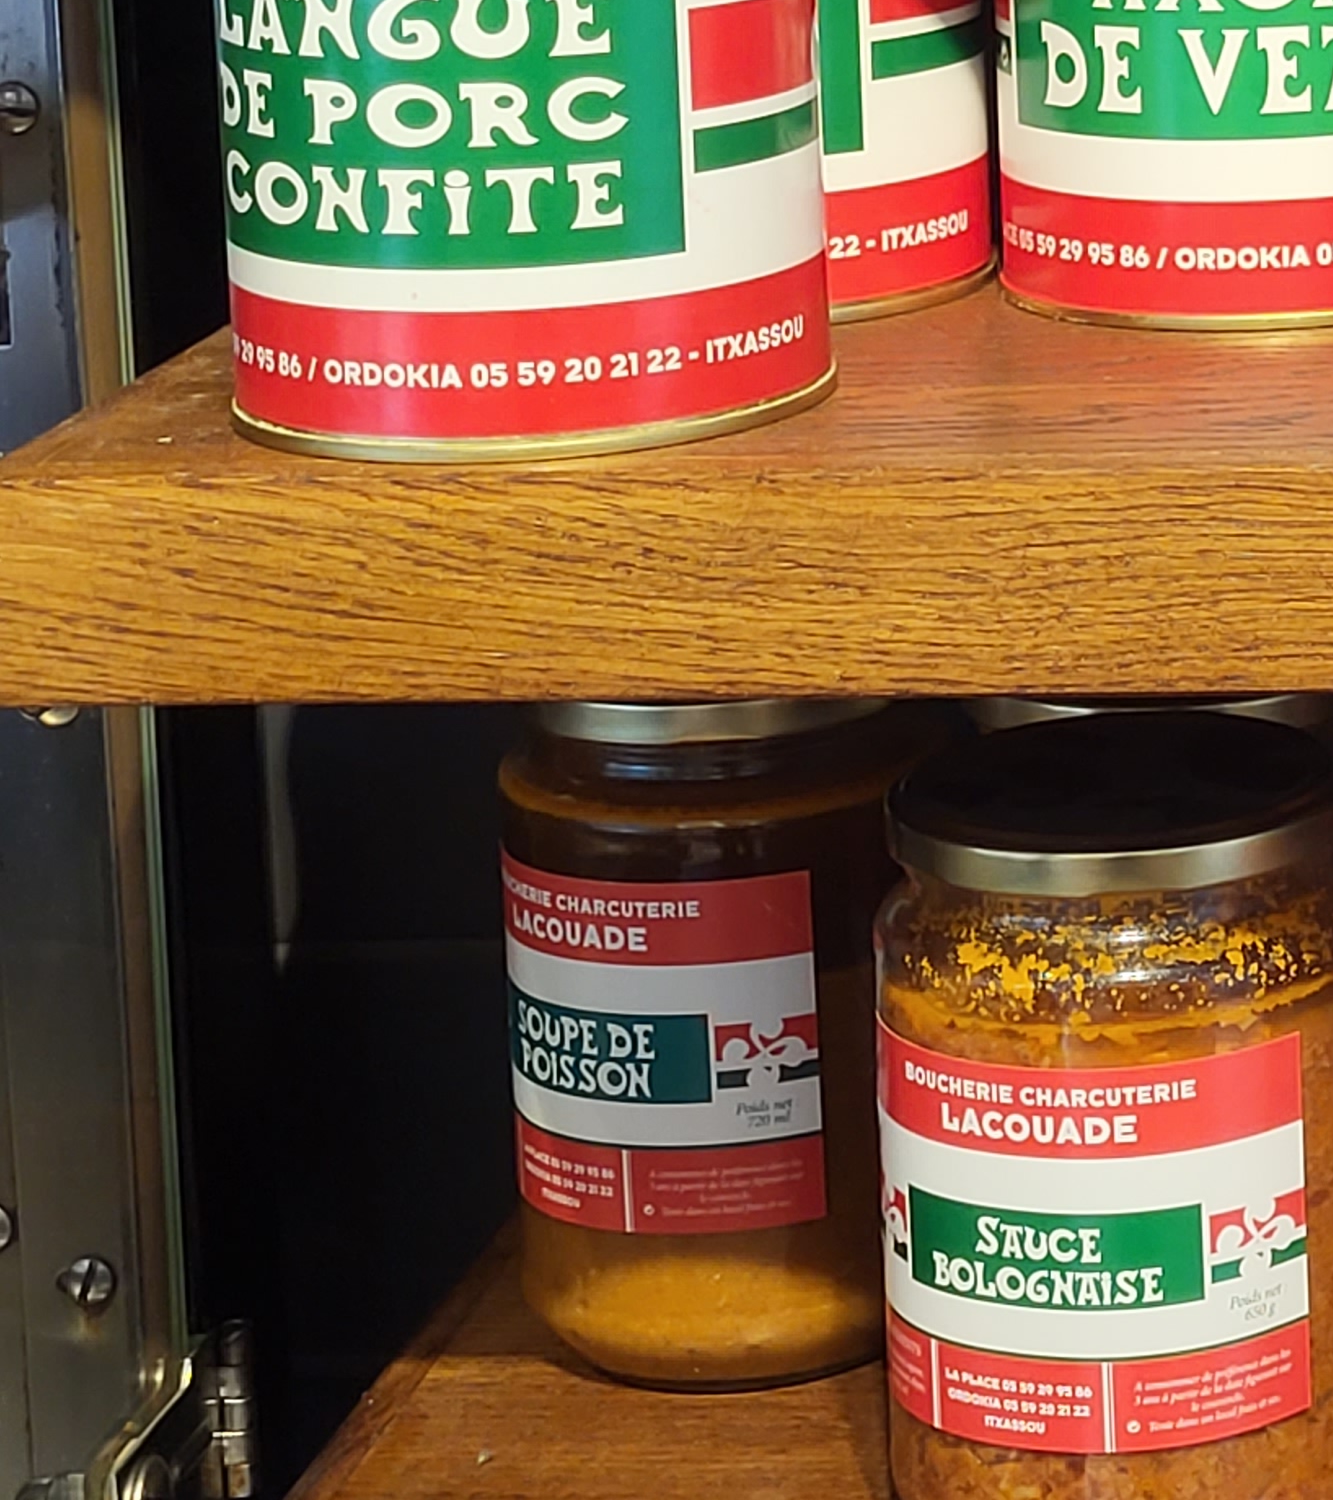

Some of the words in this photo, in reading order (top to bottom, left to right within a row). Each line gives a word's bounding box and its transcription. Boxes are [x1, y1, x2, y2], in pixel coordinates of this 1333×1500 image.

[1039, 19, 1143, 115] DE
[220, 60, 276, 138] DE
[304, 76, 630, 148] PORC
[828, 235, 862, 260] 22
[880, 209, 969, 251] ITXASSOU
[1087, 240, 1115, 267] 95
[1119, 243, 1151, 269] 86
[1174, 245, 1311, 270] ORDOKIA
[323, 358, 463, 389] ORDOKIA
[469, 362, 510, 389] 05
[516, 360, 557, 385] 59
[564, 357, 603, 383] 20
[610, 352, 640, 380] 21
[646, 346, 683, 376] 22
[705, 314, 805, 365] ITXASSOU
[512, 902, 648, 953] LACOUADE
[555, 893, 701, 919] CHARCUTERIE
[518, 998, 599, 1058] SOUPE
[607, 1023, 656, 1061] DE
[904, 1060, 1014, 1105] BOUCHERIE
[1019, 1079, 1197, 1109] CHARCUTERIE
[940, 1101, 1138, 1145] LACOUADE
[974, 1215, 1104, 1264] SAUCE
[962, 1371, 1000, 1390] PLACE
[983, 1414, 1046, 1435] ITXASSOU
